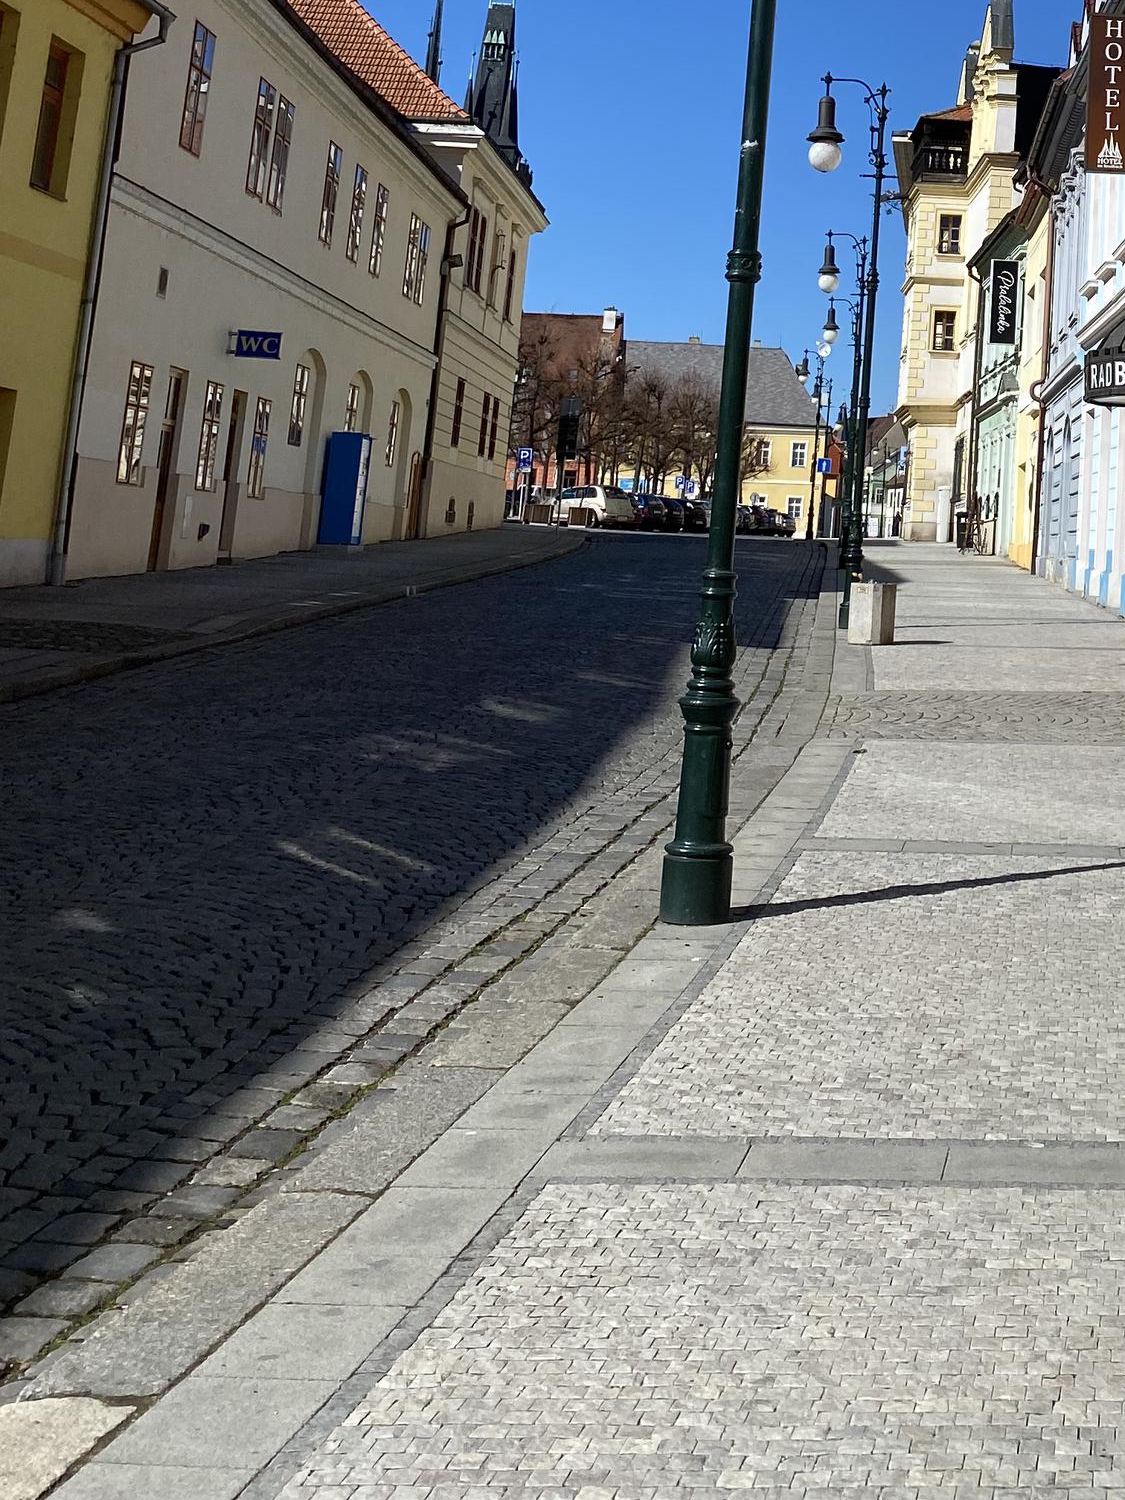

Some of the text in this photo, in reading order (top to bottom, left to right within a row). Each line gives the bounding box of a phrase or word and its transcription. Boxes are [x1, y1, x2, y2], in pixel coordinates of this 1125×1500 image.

[1104, 19, 1123, 131] HOTEL
[240, 336, 279, 353] WC
[520, 450, 529, 460] P
